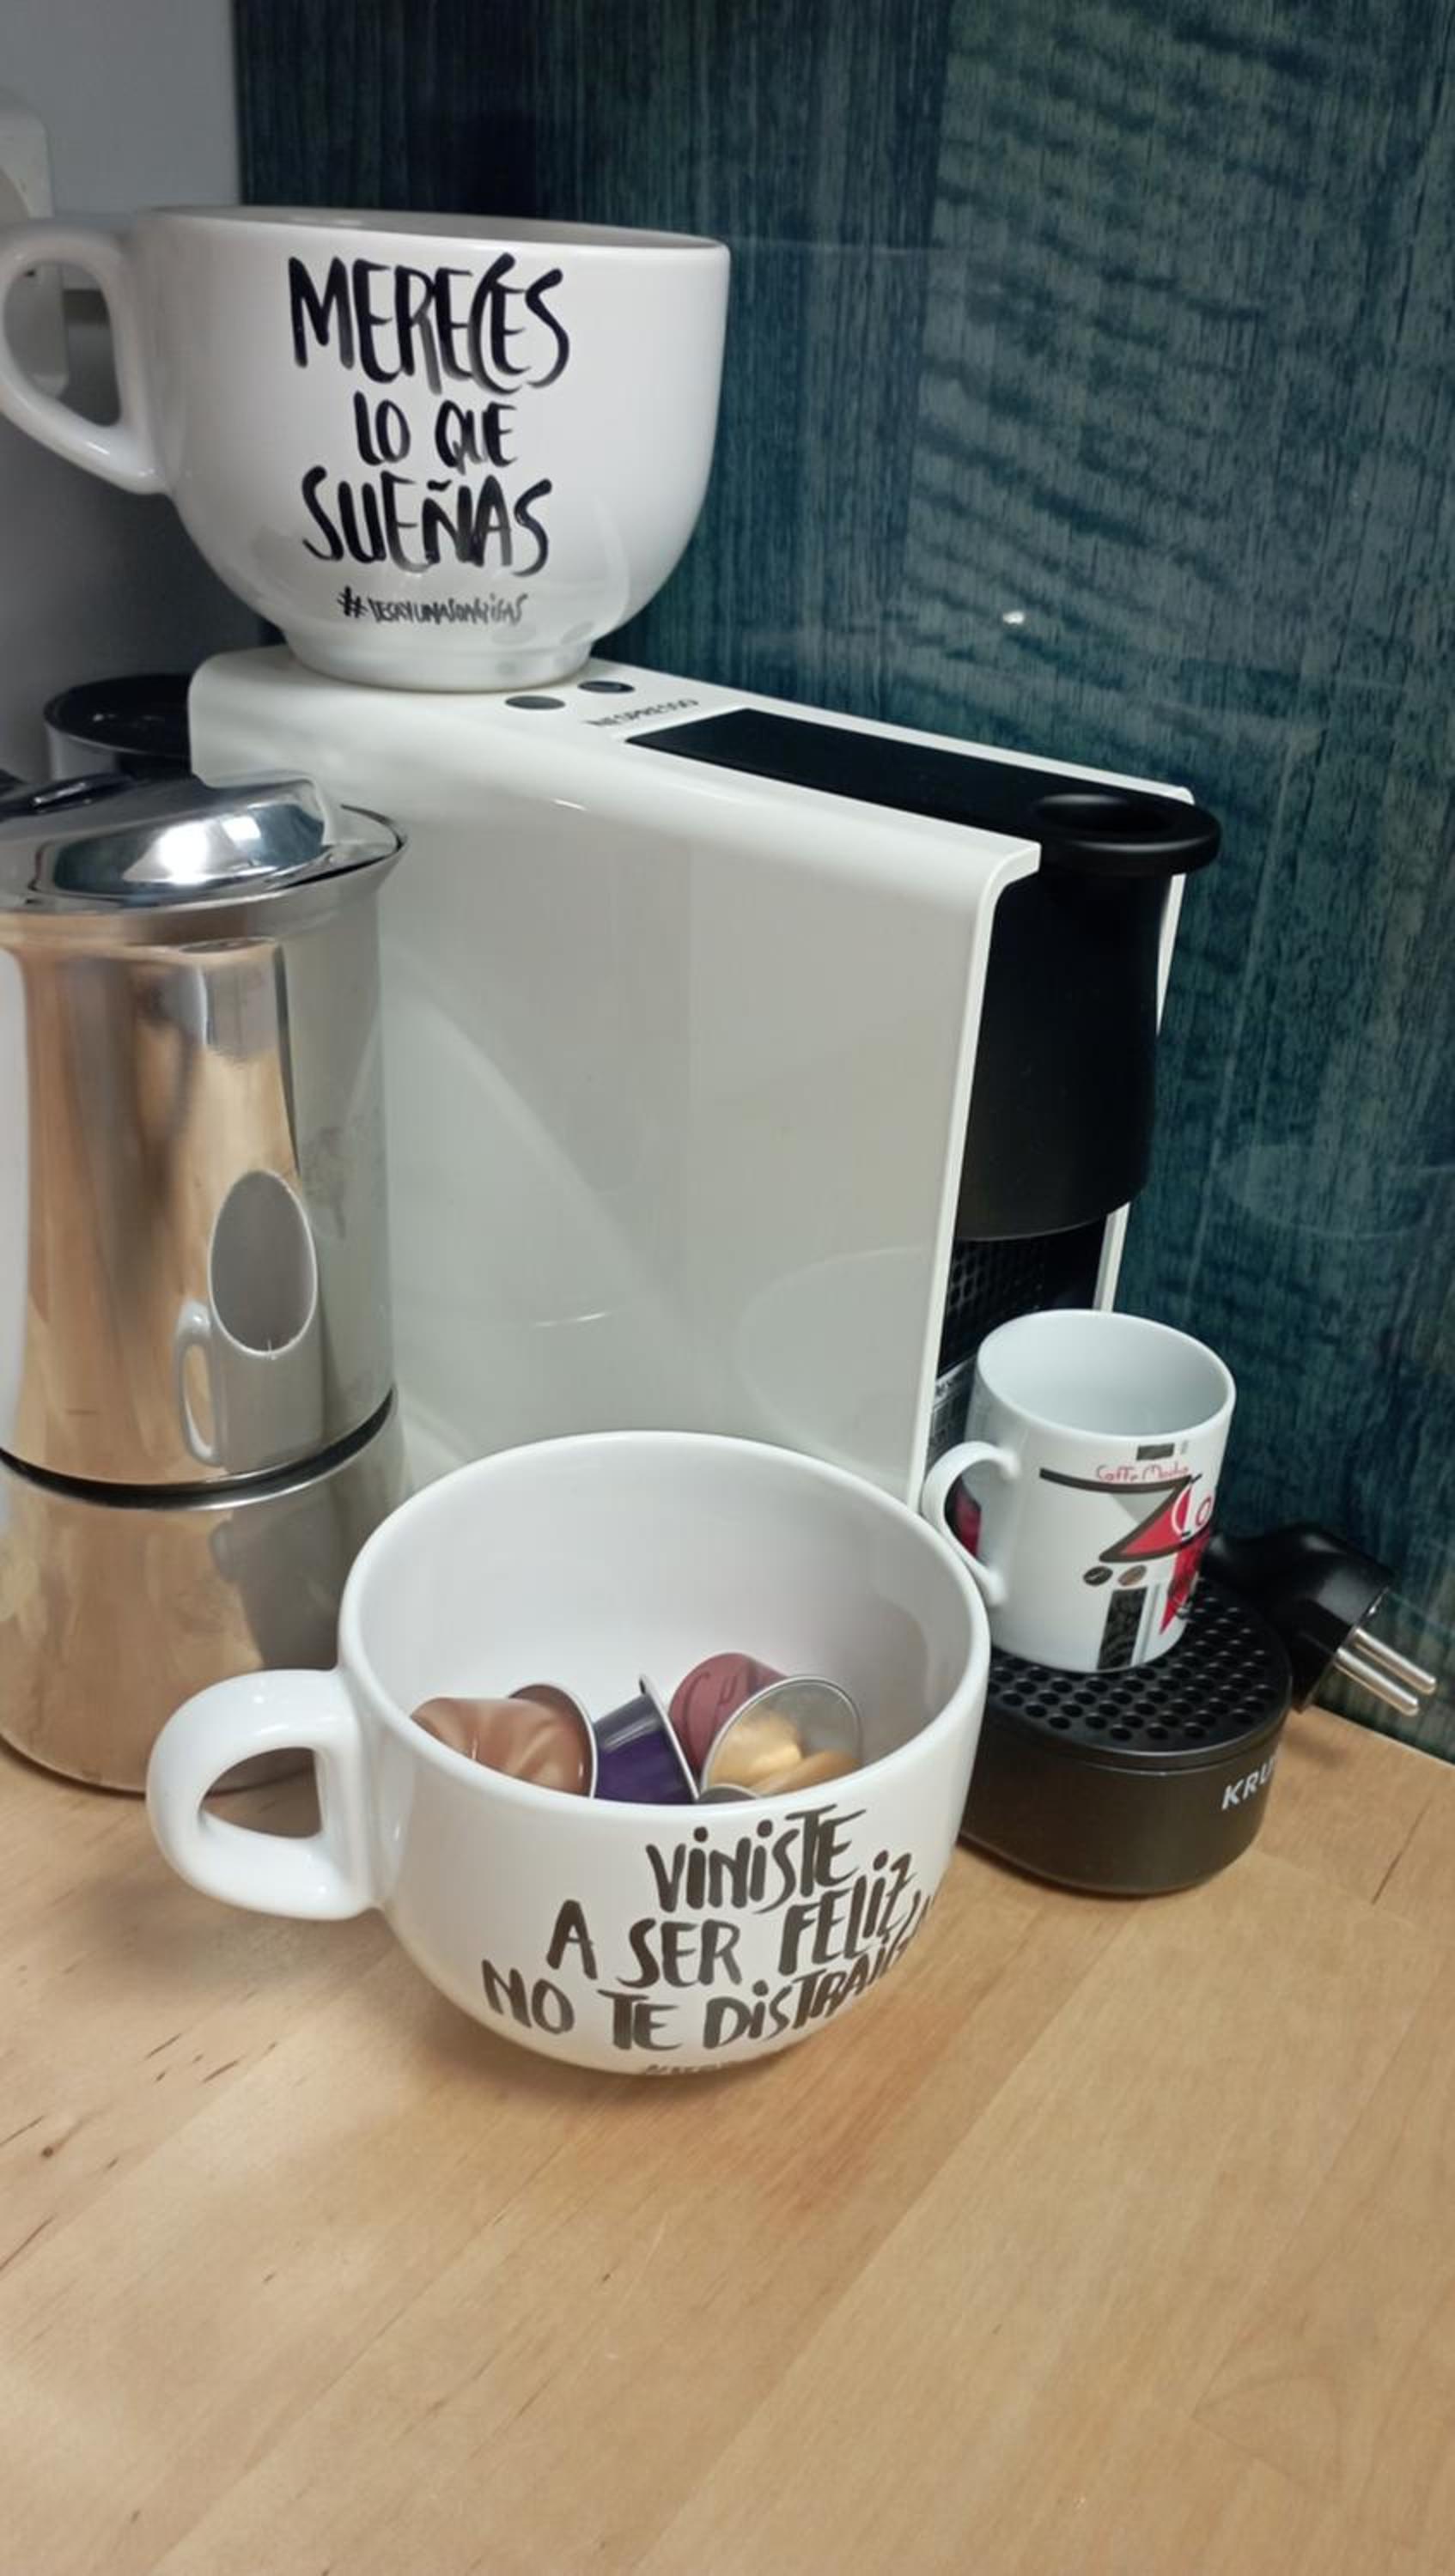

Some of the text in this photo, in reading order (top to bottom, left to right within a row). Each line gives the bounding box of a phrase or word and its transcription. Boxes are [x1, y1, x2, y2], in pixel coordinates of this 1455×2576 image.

[289, 252, 569, 395] MERECES
[354, 391, 518, 475] LO QUE
[301, 465, 552, 578] SUEÑAS
[546, 1899, 598, 1980] A
[617, 1917, 743, 1988] SER
[482, 1959, 575, 2034] NO
[597, 1989, 684, 2051] TE
